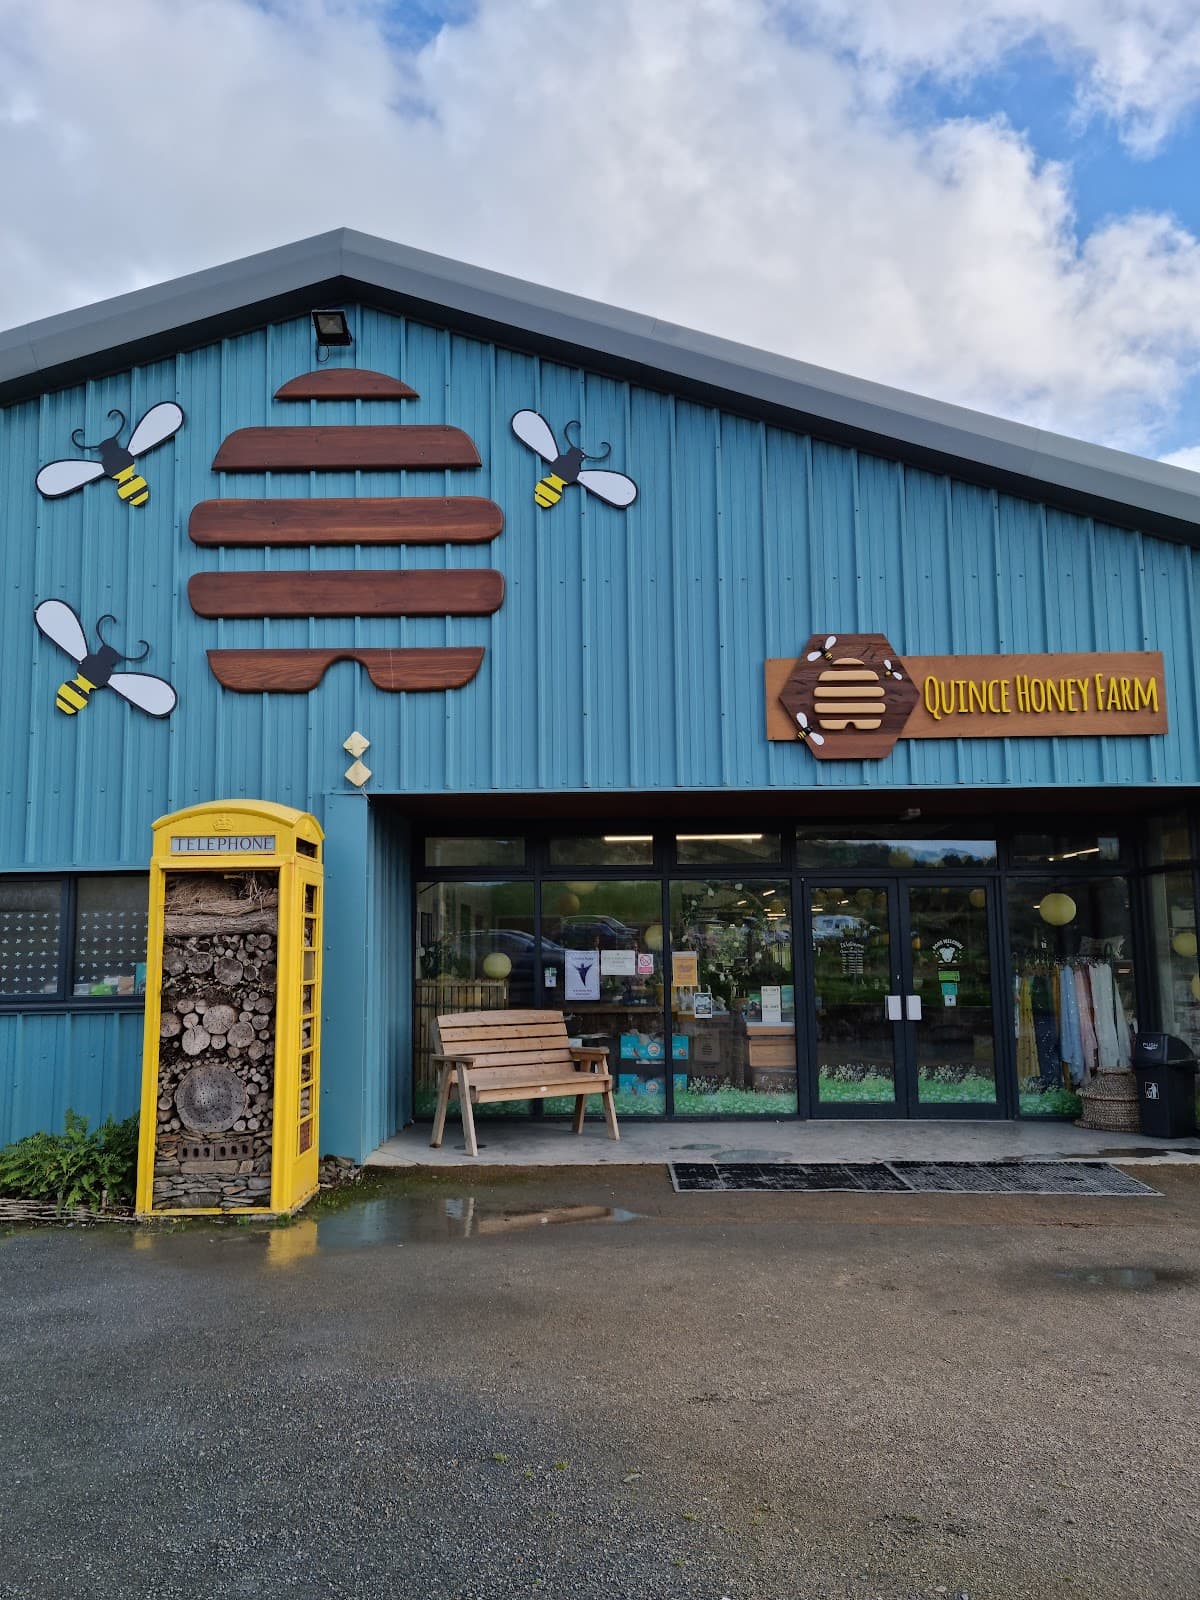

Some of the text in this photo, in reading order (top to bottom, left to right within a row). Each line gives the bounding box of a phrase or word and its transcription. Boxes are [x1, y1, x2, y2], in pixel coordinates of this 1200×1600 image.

[924, 672, 1159, 720] QUINCE HONEY FARM
[176, 837, 273, 851] TELEPHONE
